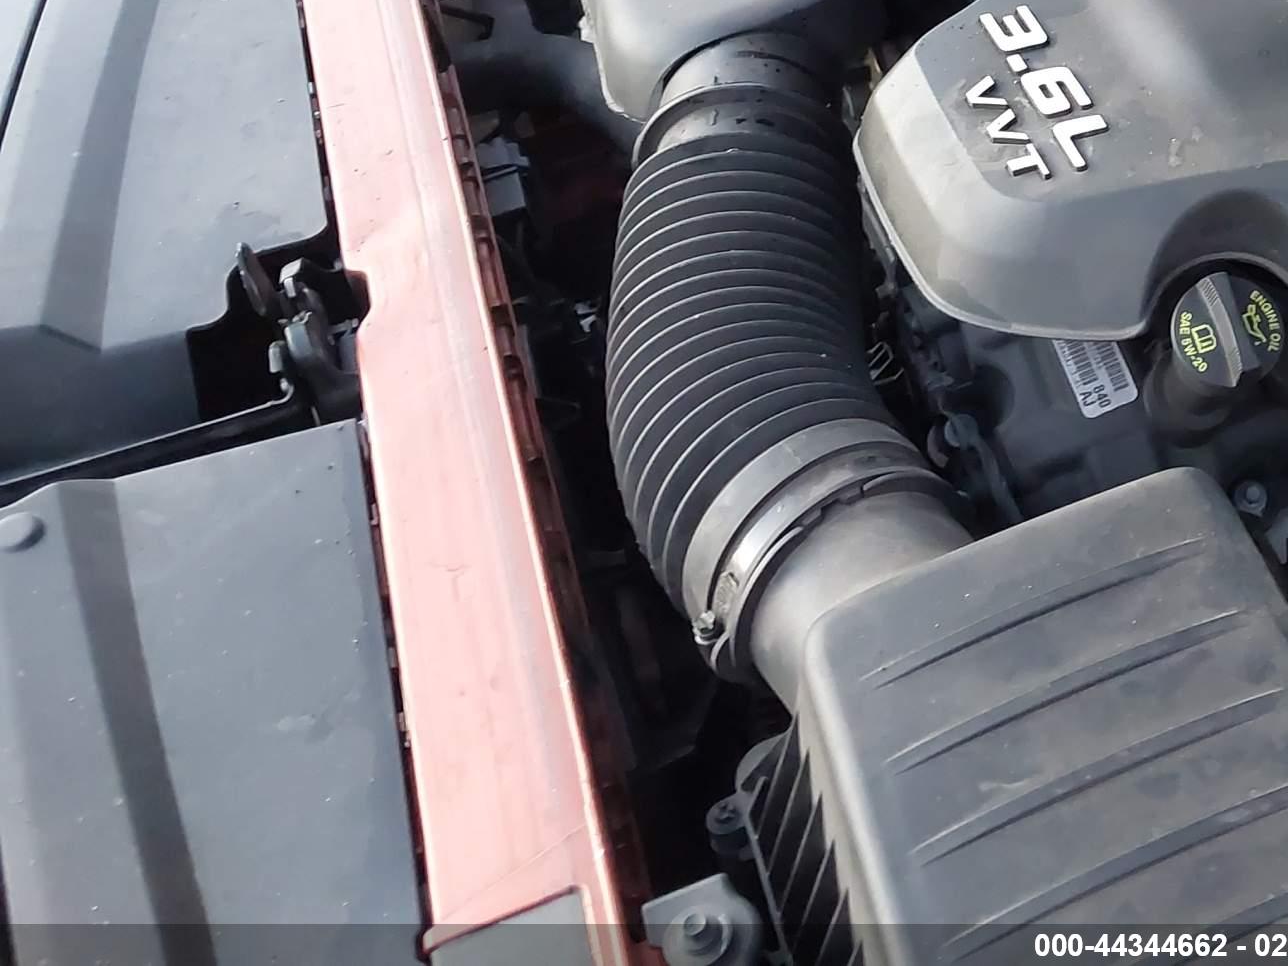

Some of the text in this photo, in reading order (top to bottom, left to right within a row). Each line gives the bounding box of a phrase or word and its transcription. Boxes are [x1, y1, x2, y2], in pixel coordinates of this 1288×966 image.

[979, 4, 1110, 172] 3.6L
[965, 75, 1052, 180] VVT
[1179, 311, 1208, 372] SAE 5W-20
[1249, 290, 1281, 352] ENGINE OIL
[1080, 391, 1097, 407] AJ
